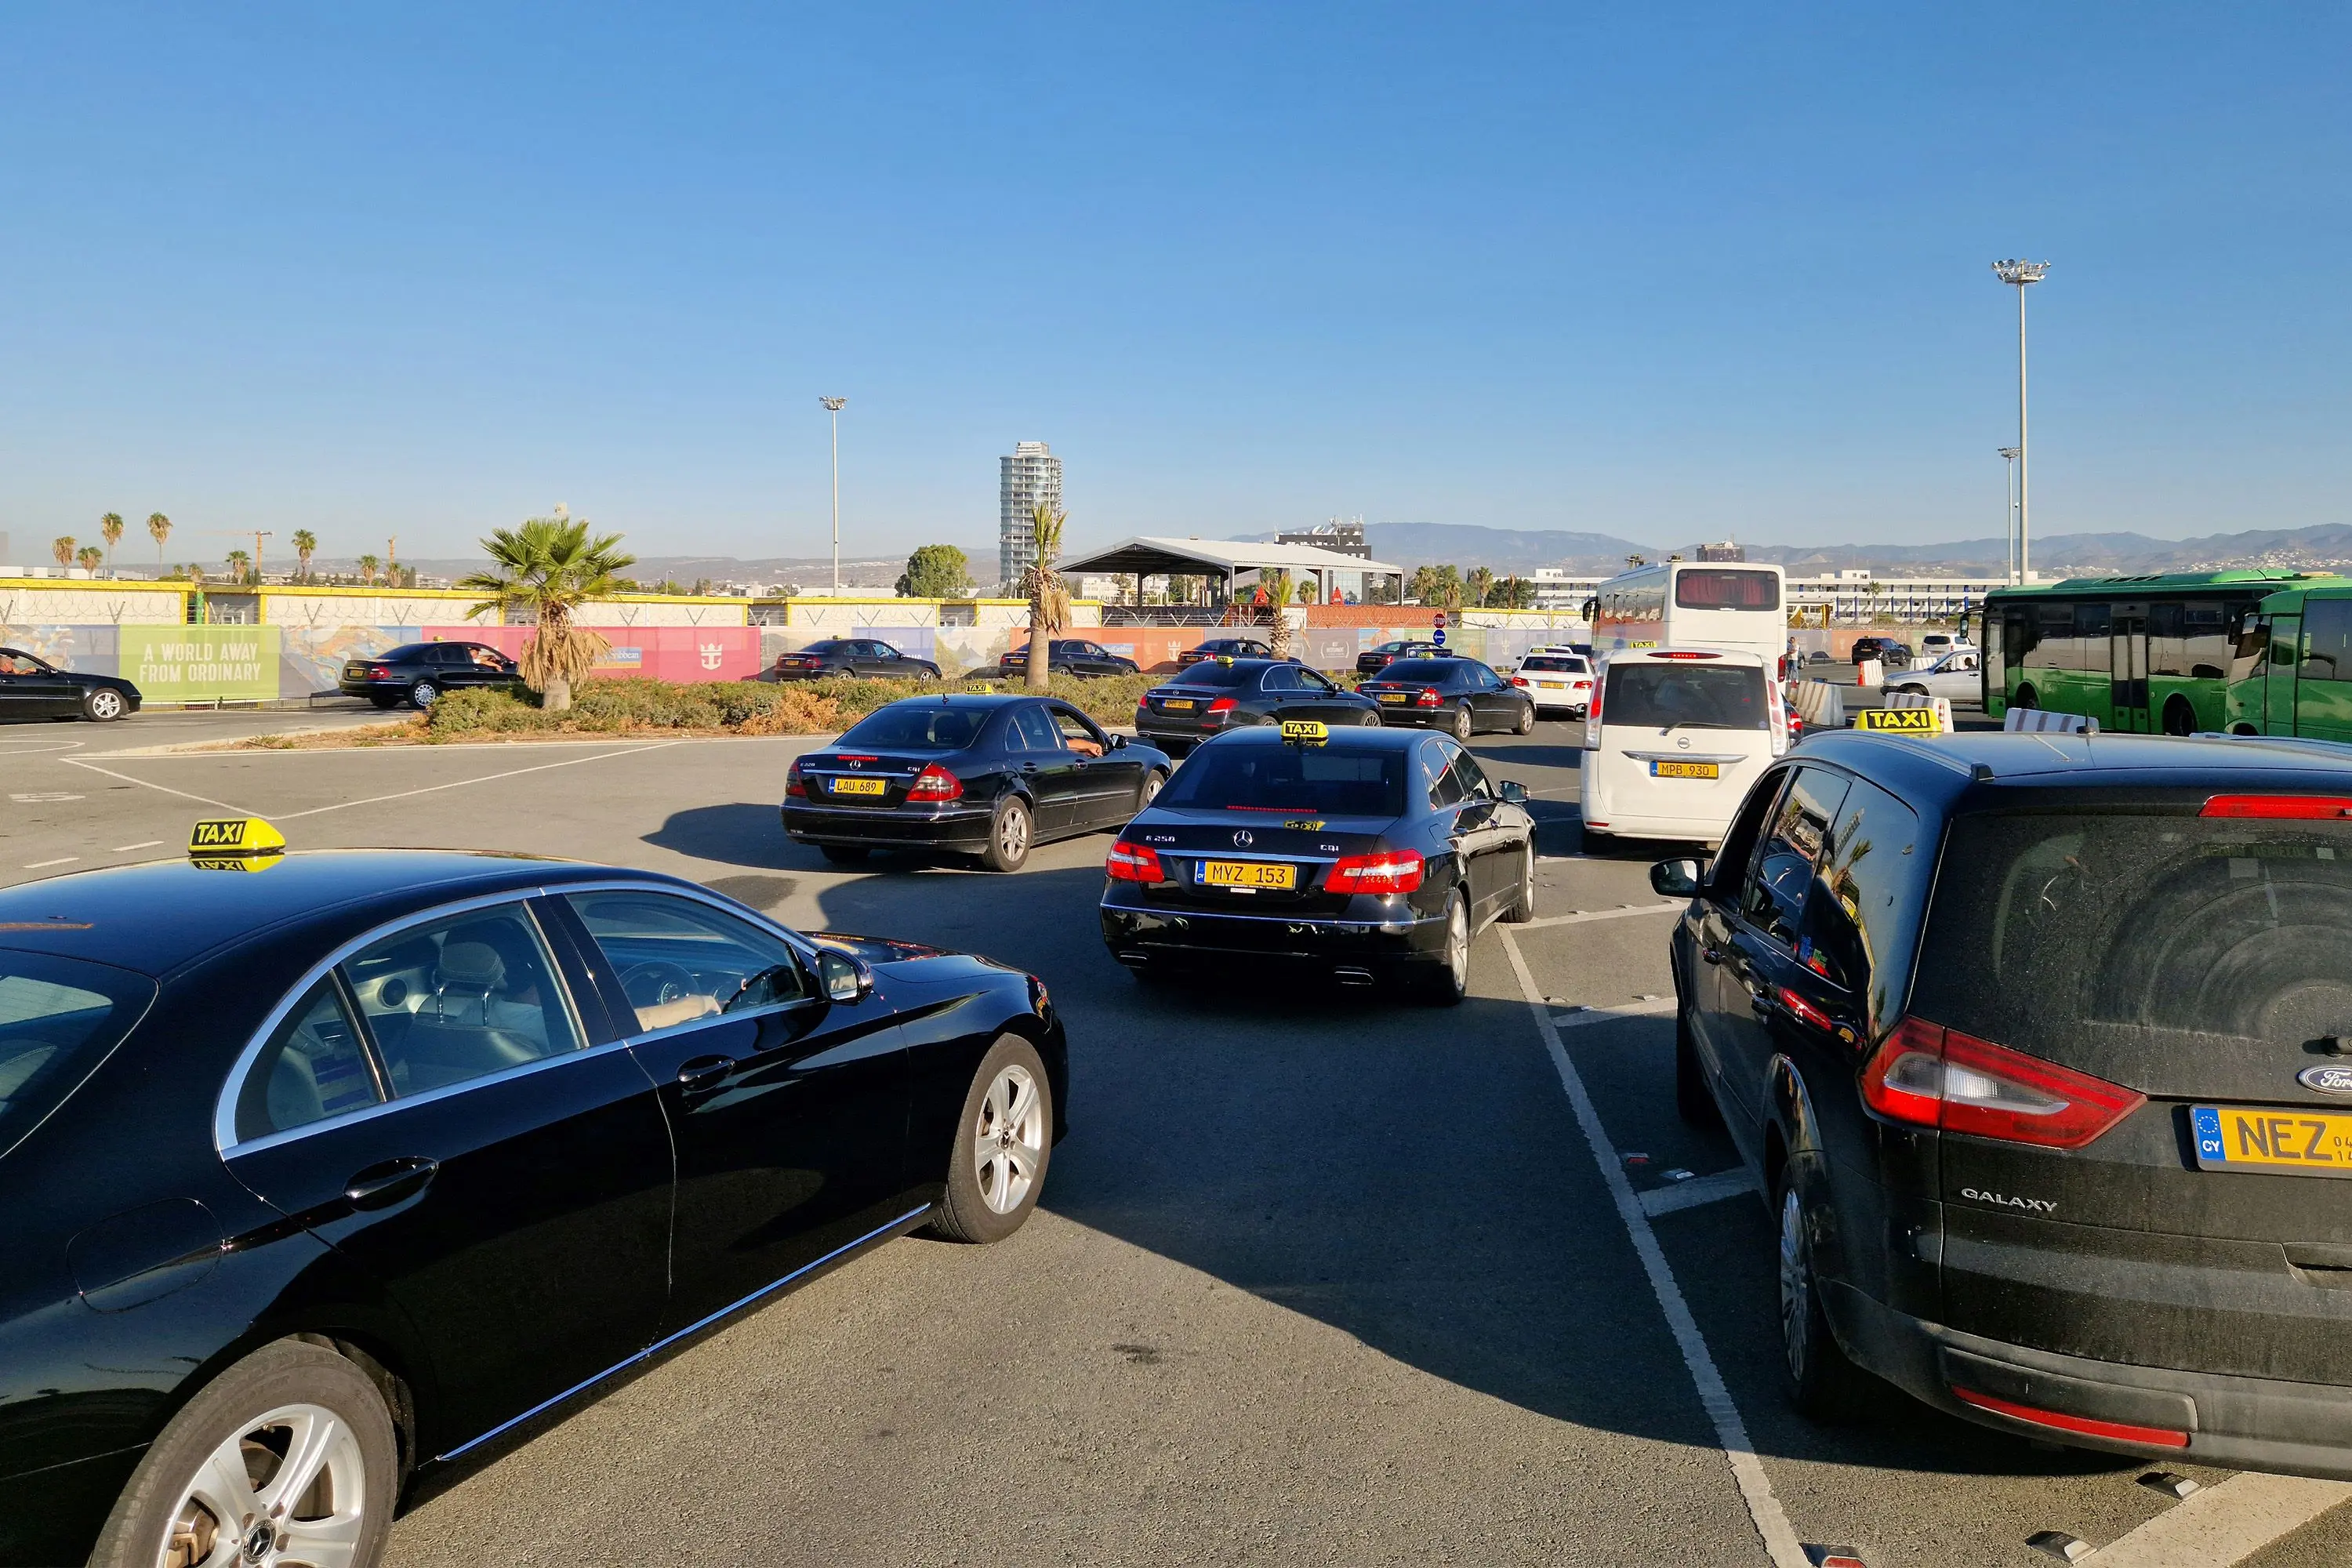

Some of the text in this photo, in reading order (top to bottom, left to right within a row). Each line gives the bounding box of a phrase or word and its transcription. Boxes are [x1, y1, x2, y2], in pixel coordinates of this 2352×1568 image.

[143, 643, 258, 662] A WORLD AWAY
[140, 662, 261, 683] FROM ORDINARY
[1287, 724, 1316, 734] TAXI
[1869, 711, 1928, 728] TAXI
[1661, 764, 1709, 776] MPB 930
[837, 781, 877, 792] LAU 689
[198, 823, 244, 844] TAXI
[1212, 865, 1286, 884] MYZ 153
[2202, 1140, 2220, 1152] CY
[2236, 1116, 2333, 1161] NEZ
[1961, 1188, 2057, 1211] GALAXY
